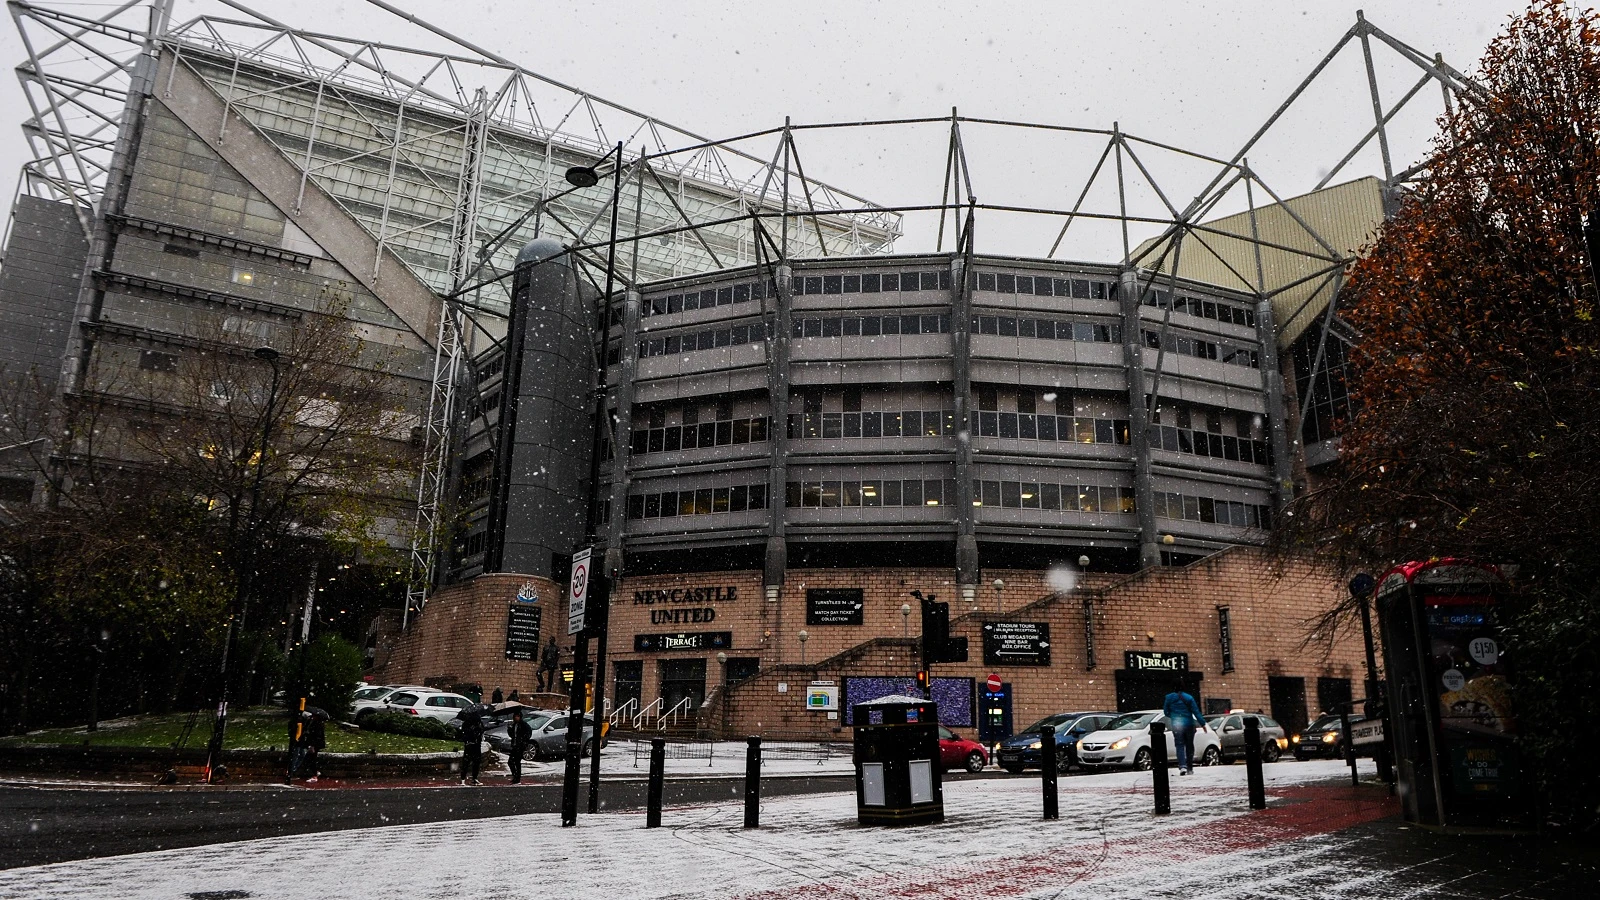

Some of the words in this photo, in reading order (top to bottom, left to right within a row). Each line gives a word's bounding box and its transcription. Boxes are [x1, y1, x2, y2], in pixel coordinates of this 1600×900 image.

[575, 574, 584, 588] 20
[634, 586, 737, 605] NEWCASTLE
[571, 600, 583, 612] ZONE
[651, 608, 716, 624] UNITED
[665, 636, 696, 648] TERRACE
[1136, 655, 1178, 670] TERRACE
[1352, 726, 1373, 740] STRAWBERRY
